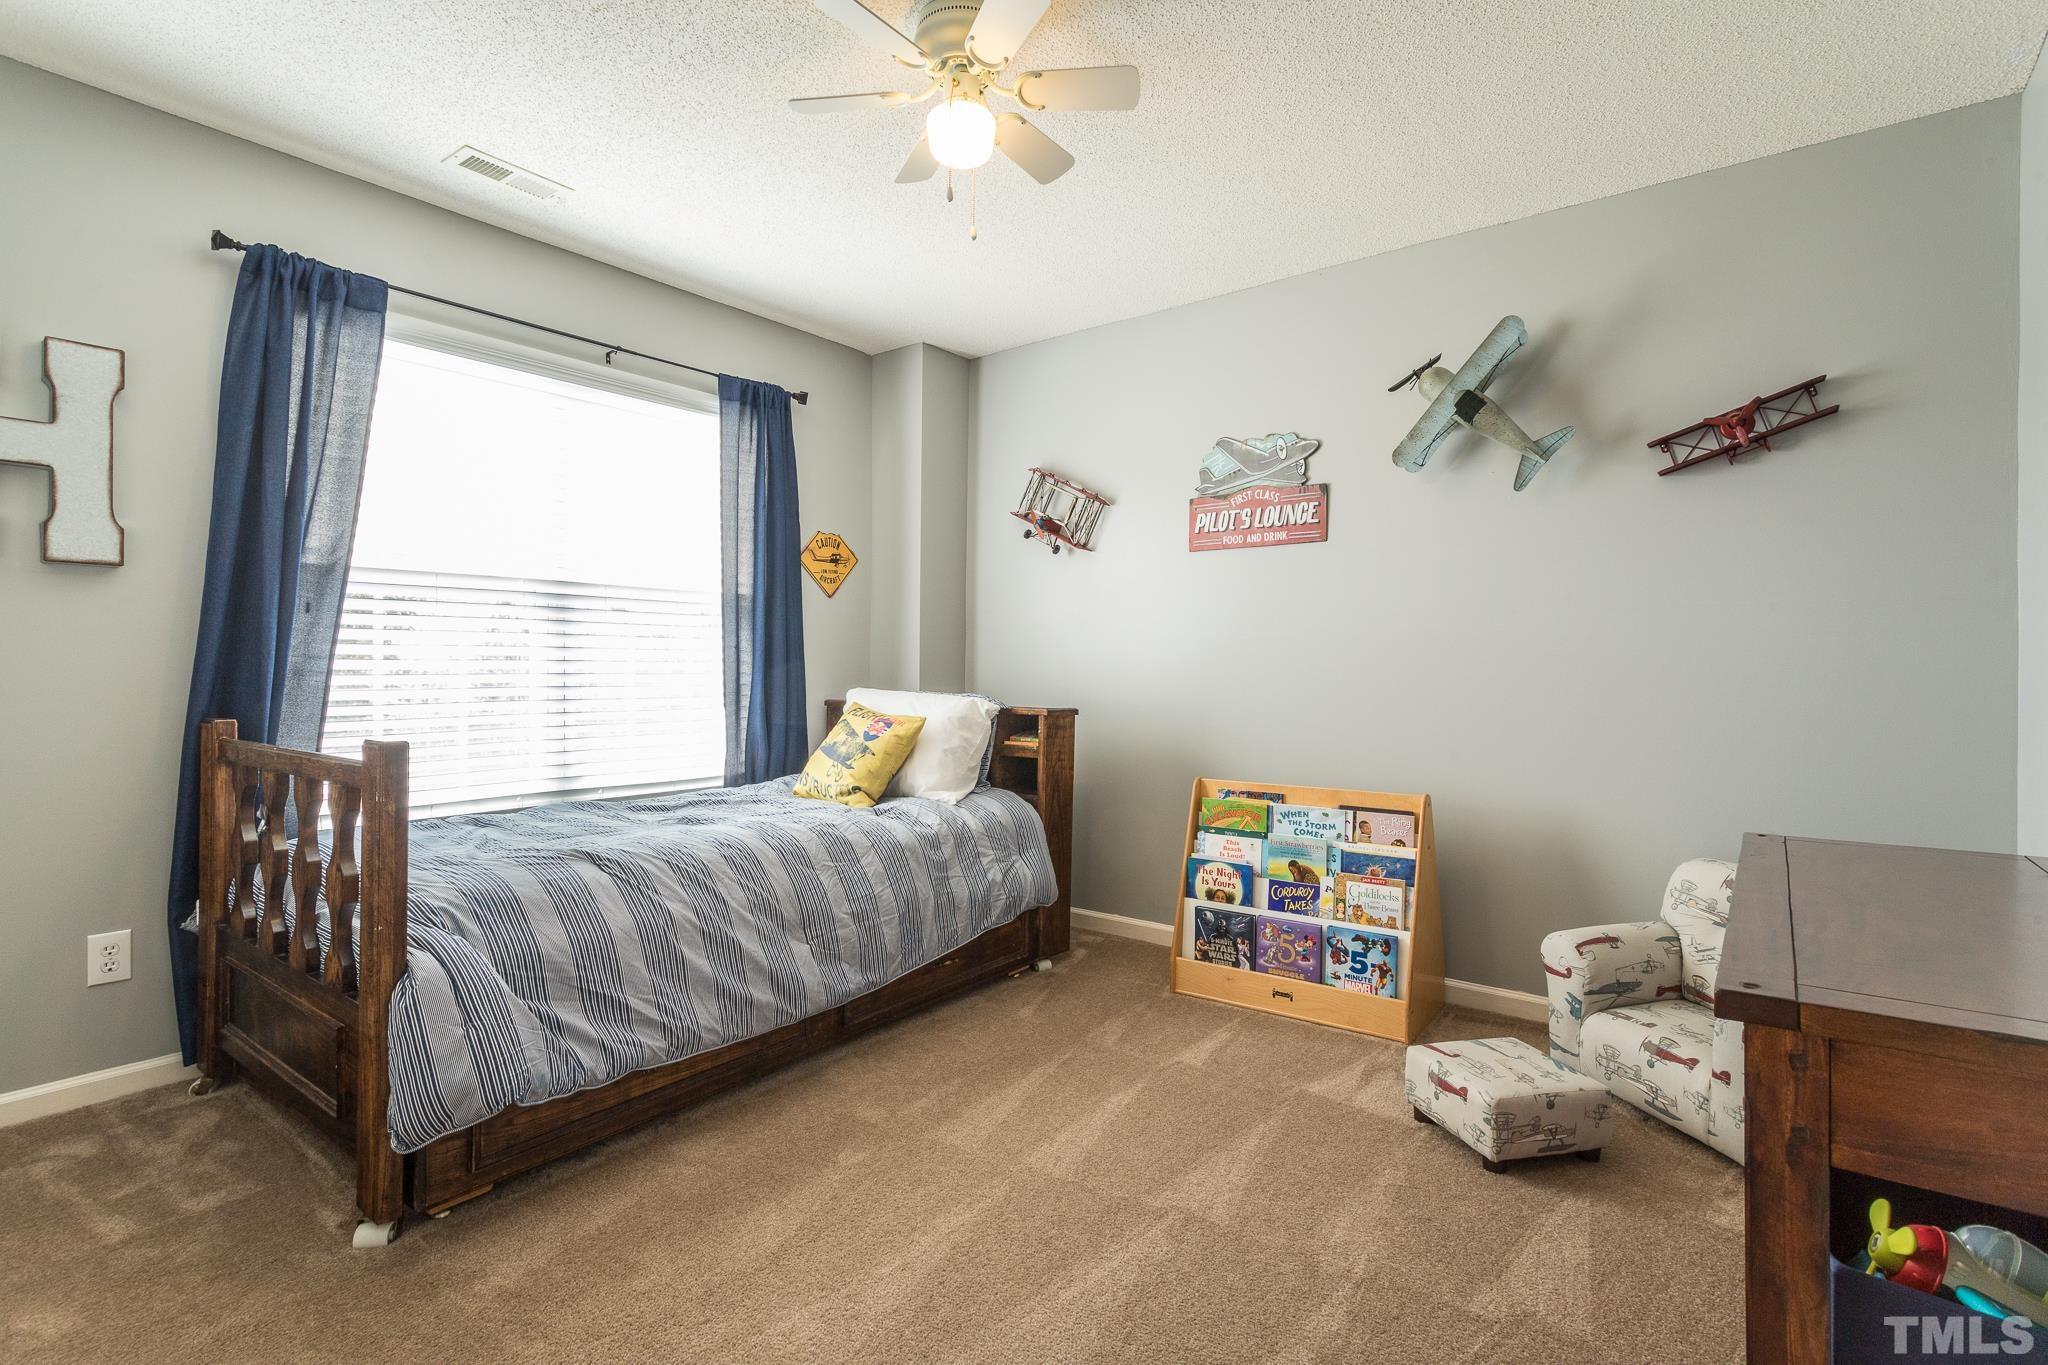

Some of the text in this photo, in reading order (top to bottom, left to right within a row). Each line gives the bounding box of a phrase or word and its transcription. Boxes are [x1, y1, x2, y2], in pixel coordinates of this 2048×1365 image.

[1231, 490, 1280, 507] FIRST CLASS
[1194, 502, 1320, 534] PILOT'S LOUNGE
[815, 536, 841, 550] CAUTION
[1222, 530, 1288, 545] FOOD AND DRINK
[819, 574, 841, 585] AIRCRAFT
[1280, 810, 1309, 820] WHEN
[1288, 819, 1302, 827] THE
[1304, 819, 1337, 831] STORM
[1293, 827, 1325, 839] COMES
[1222, 845, 1242, 853] Beach
[1197, 864, 1242, 880] The Night
[1201, 876, 1237, 890] Is Yours
[1271, 884, 1315, 900] CORDUROY
[1348, 883, 1400, 903] Goldilocks
[1284, 898, 1313, 911] TAKES
[1207, 943, 1237, 955] STAR
[1207, 950, 1237, 962] WARS
[1277, 934, 1296, 964] 5
[1349, 950, 1368, 975] 5
[1344, 973, 1373, 984] MINUTE
[1344, 980, 1372, 994] MARVEL
